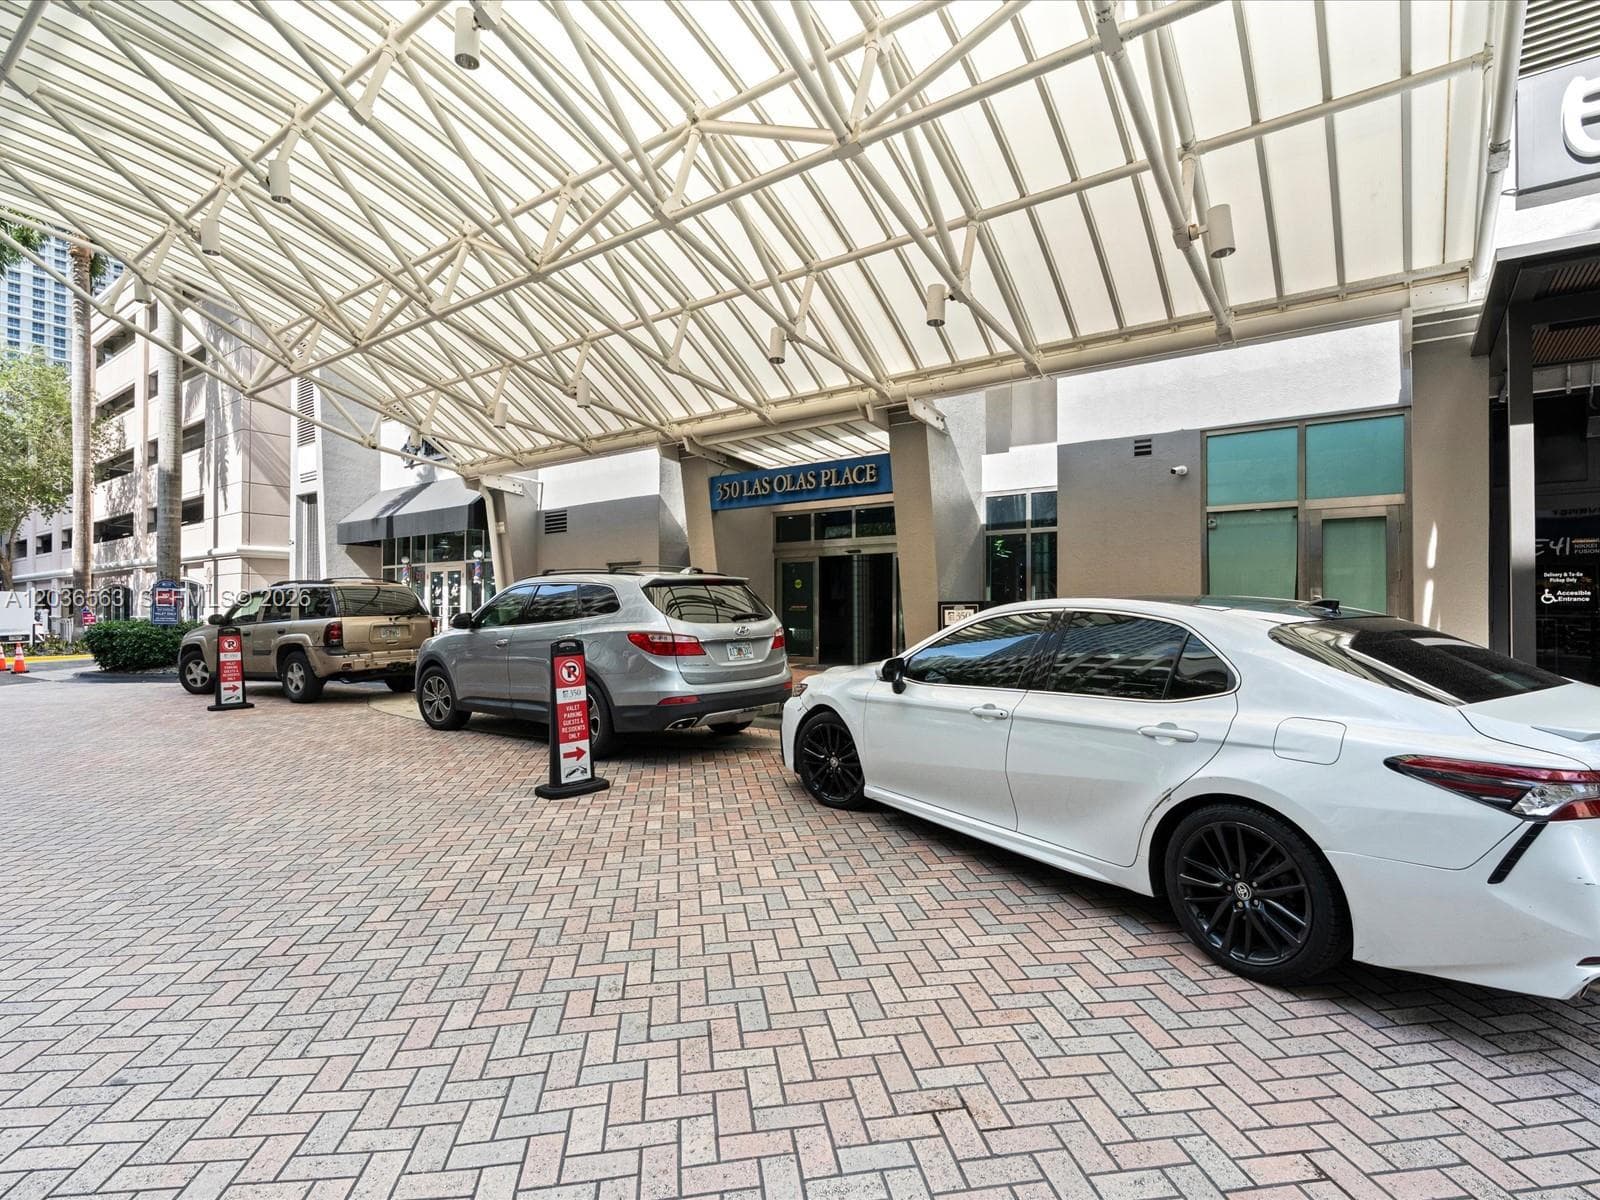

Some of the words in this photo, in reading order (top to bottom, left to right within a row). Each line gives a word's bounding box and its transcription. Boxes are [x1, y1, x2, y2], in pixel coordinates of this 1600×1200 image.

[716, 481, 740, 501] 350
[742, 476, 770, 497] LAS
[773, 470, 816, 493] OLAS
[820, 463, 877, 488] PLACE
[570, 688, 582, 698] 350
[566, 704, 580, 712] VALET
[563, 711, 583, 719] PARKING
[562, 718, 580, 727] GUESTS
[561, 724, 586, 734] RESIDENTS
[568, 732, 581, 740] ONLY
